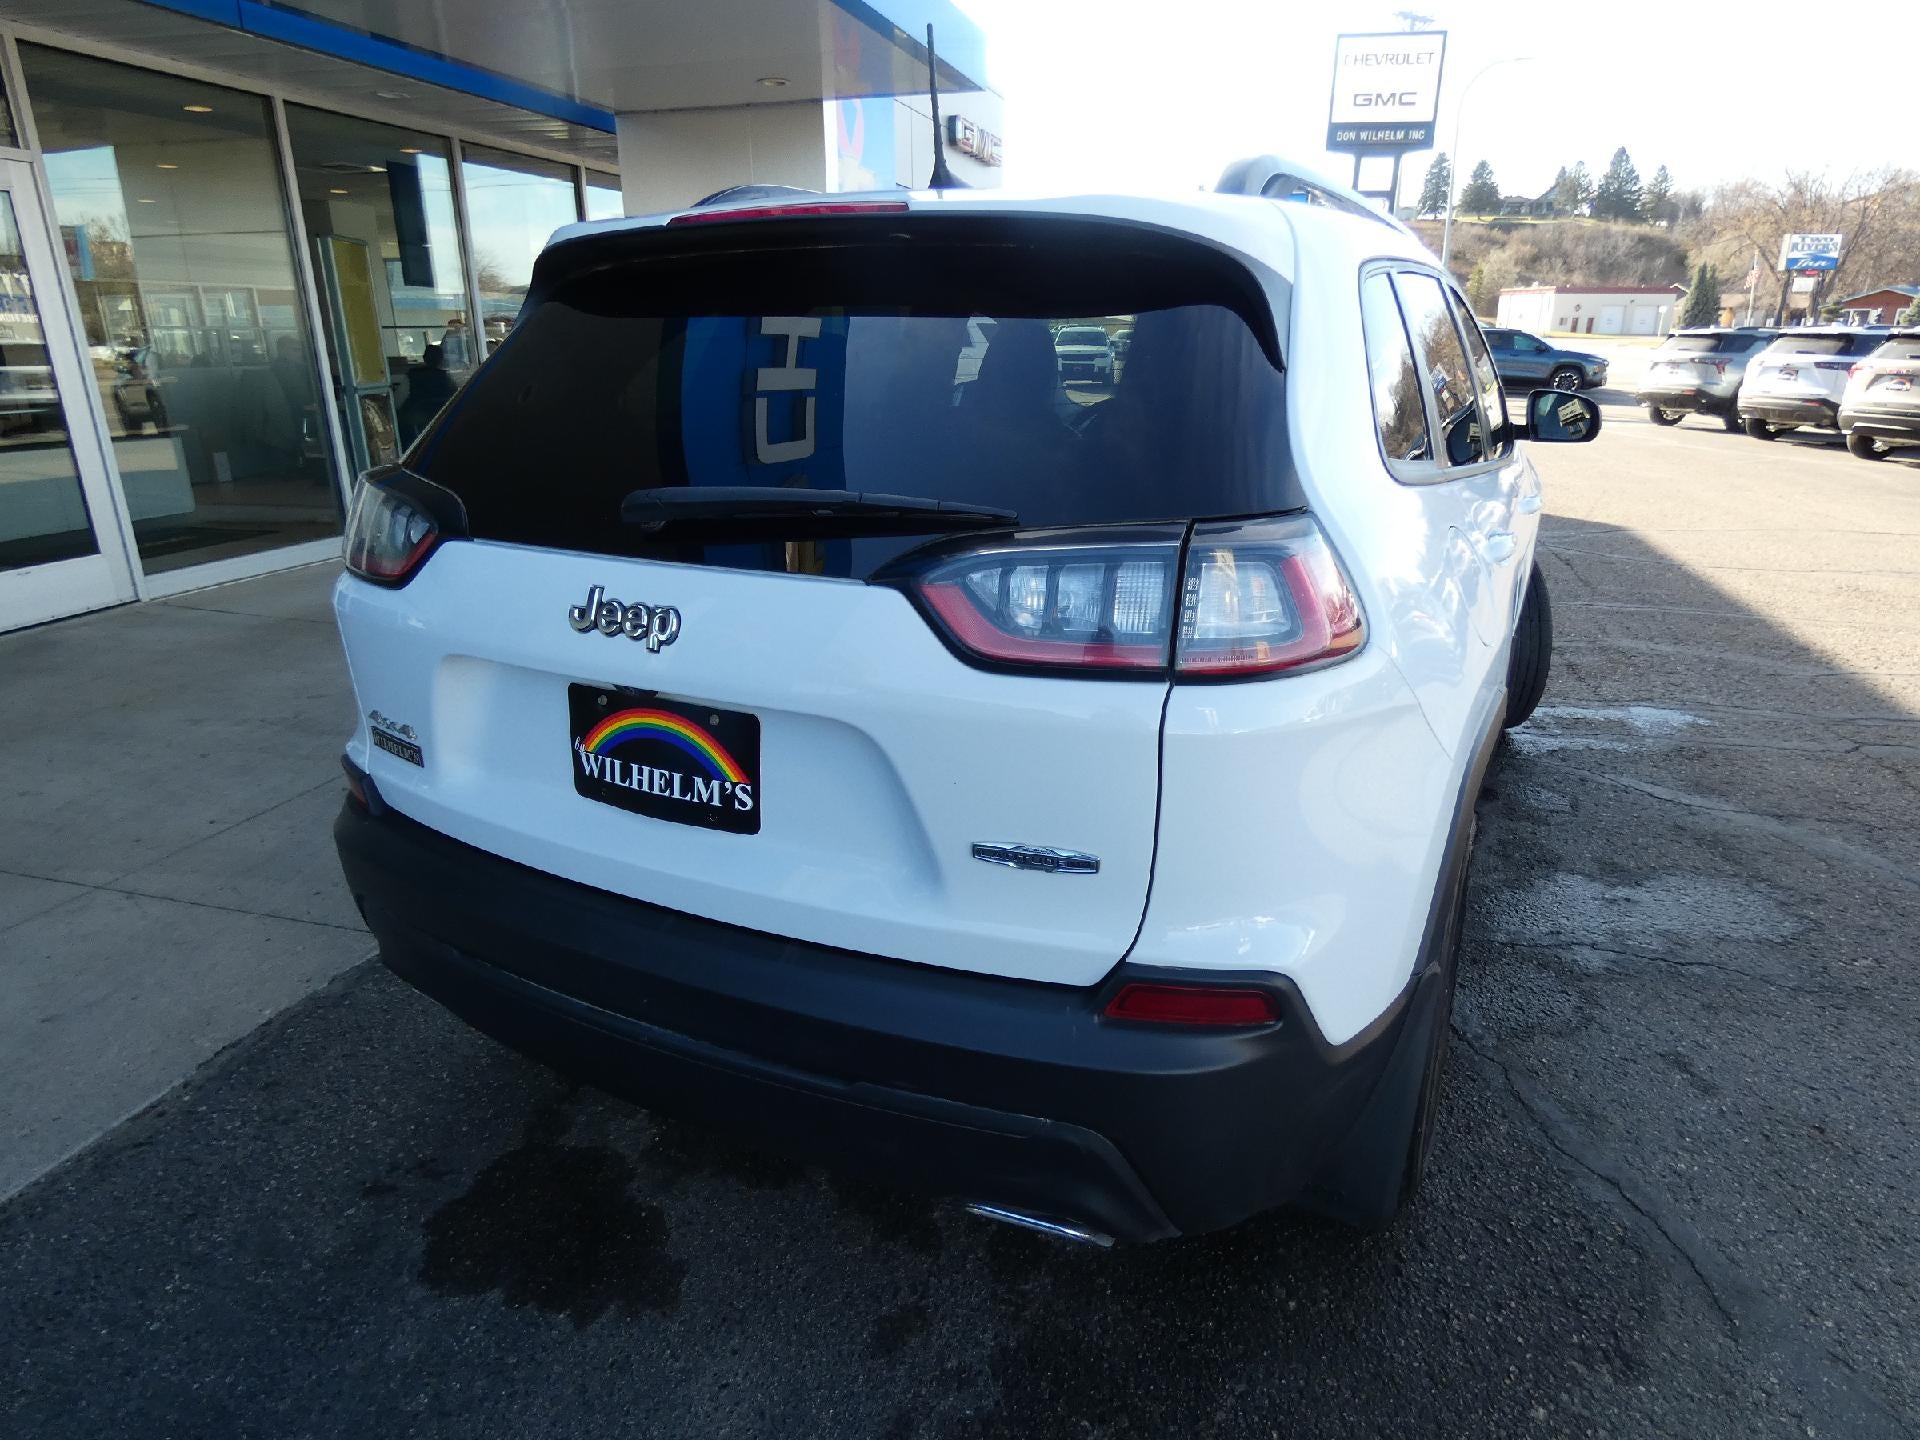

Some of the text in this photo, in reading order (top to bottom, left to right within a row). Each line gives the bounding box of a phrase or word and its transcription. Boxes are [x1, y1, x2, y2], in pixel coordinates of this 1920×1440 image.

[1344, 52, 1434, 66] CHEVROLET
[1353, 92, 1417, 107] GMC
[1337, 129, 1425, 142] DON WILHELM INC
[569, 584, 682, 654] Jeep
[579, 749, 754, 812] WILHELM'S
